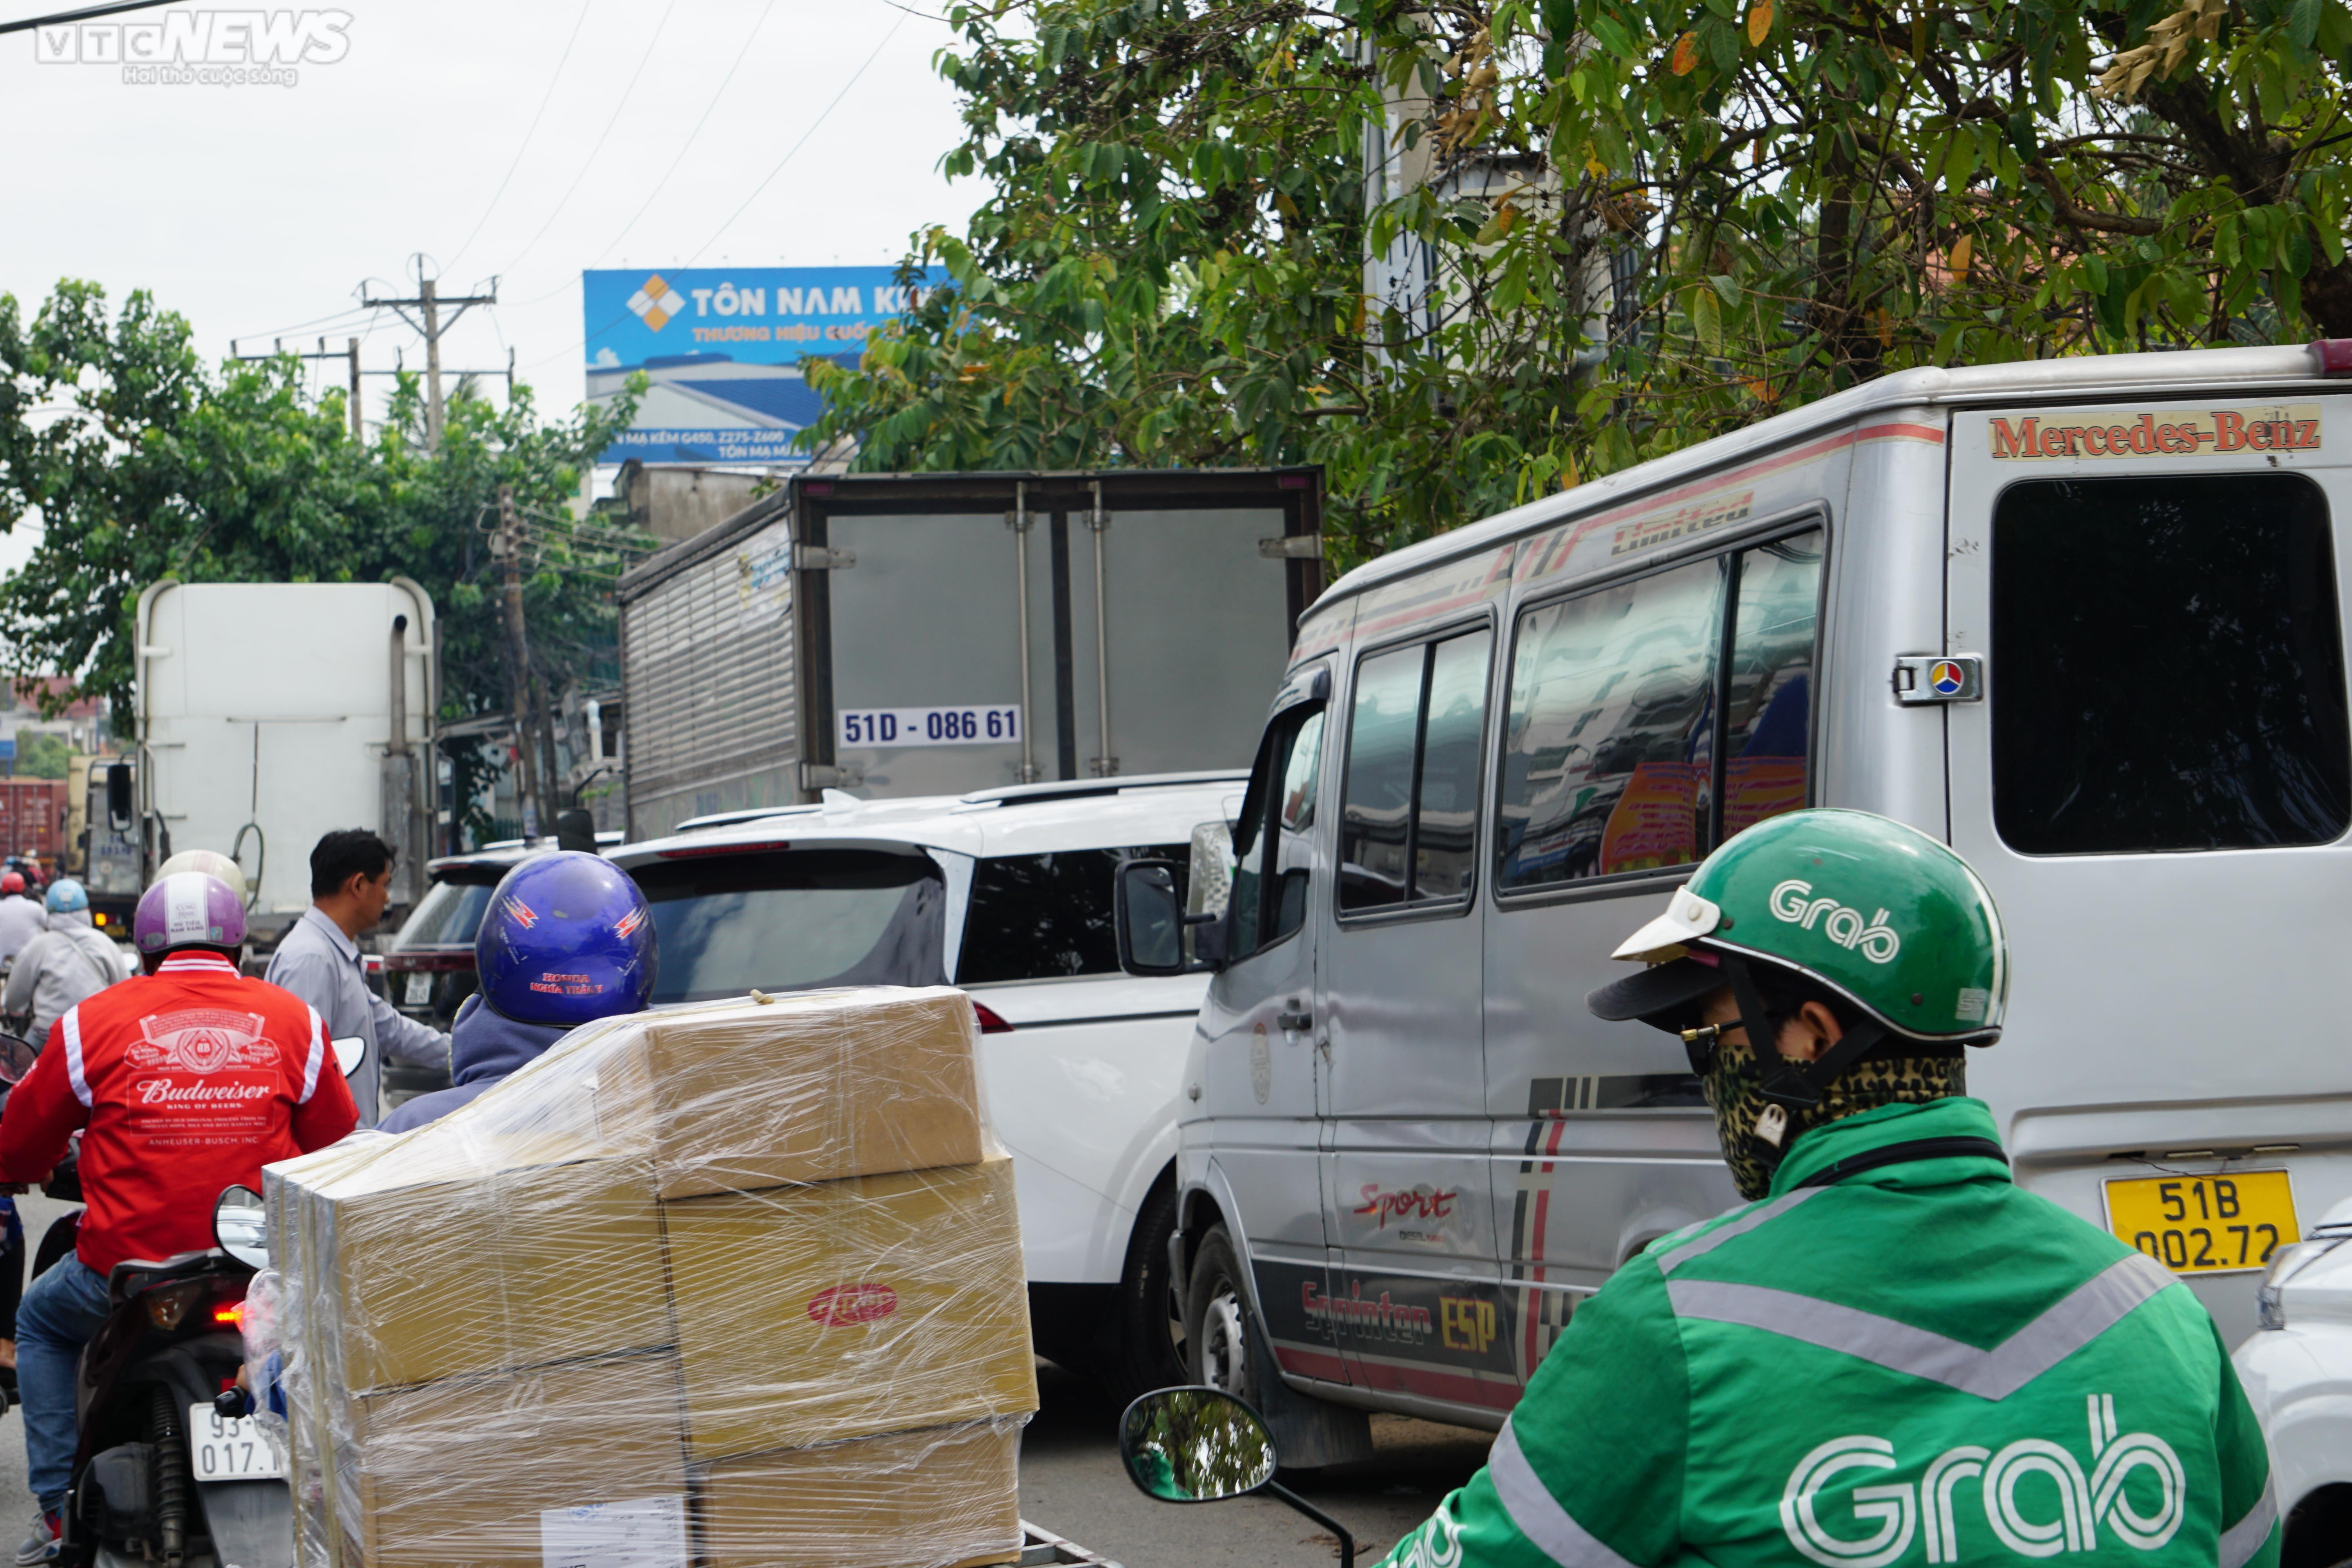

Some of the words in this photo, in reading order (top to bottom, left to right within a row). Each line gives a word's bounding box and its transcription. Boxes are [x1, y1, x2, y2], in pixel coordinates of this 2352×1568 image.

[691, 282, 765, 316] TÔN
[777, 287, 862, 314] NAM
[692, 326, 770, 342] THƯƠNG
[776, 323, 820, 343] HIỆU
[718, 444, 747, 459] TÔN
[1990, 411, 2320, 459] Mercedes-Benz
[1611, 492, 1754, 556] Limited
[845, 713, 897, 743] 51D
[927, 711, 977, 739] 086
[987, 710, 1016, 739] 61
[1768, 879, 1900, 964] Grab
[530, 982, 564, 994] NGHĨA
[542, 972, 591, 984] HONDA
[136, 1078, 270, 1104] Budweiser
[1353, 1183, 1457, 1230] Sport
[2159, 1179, 2240, 1221] 51B
[2135, 1223, 2279, 1268] 002.72
[1302, 1279, 1432, 1345] Sprinter
[1439, 1296, 1496, 1354] ESP
[1779, 1394, 2186, 1568] Grab
